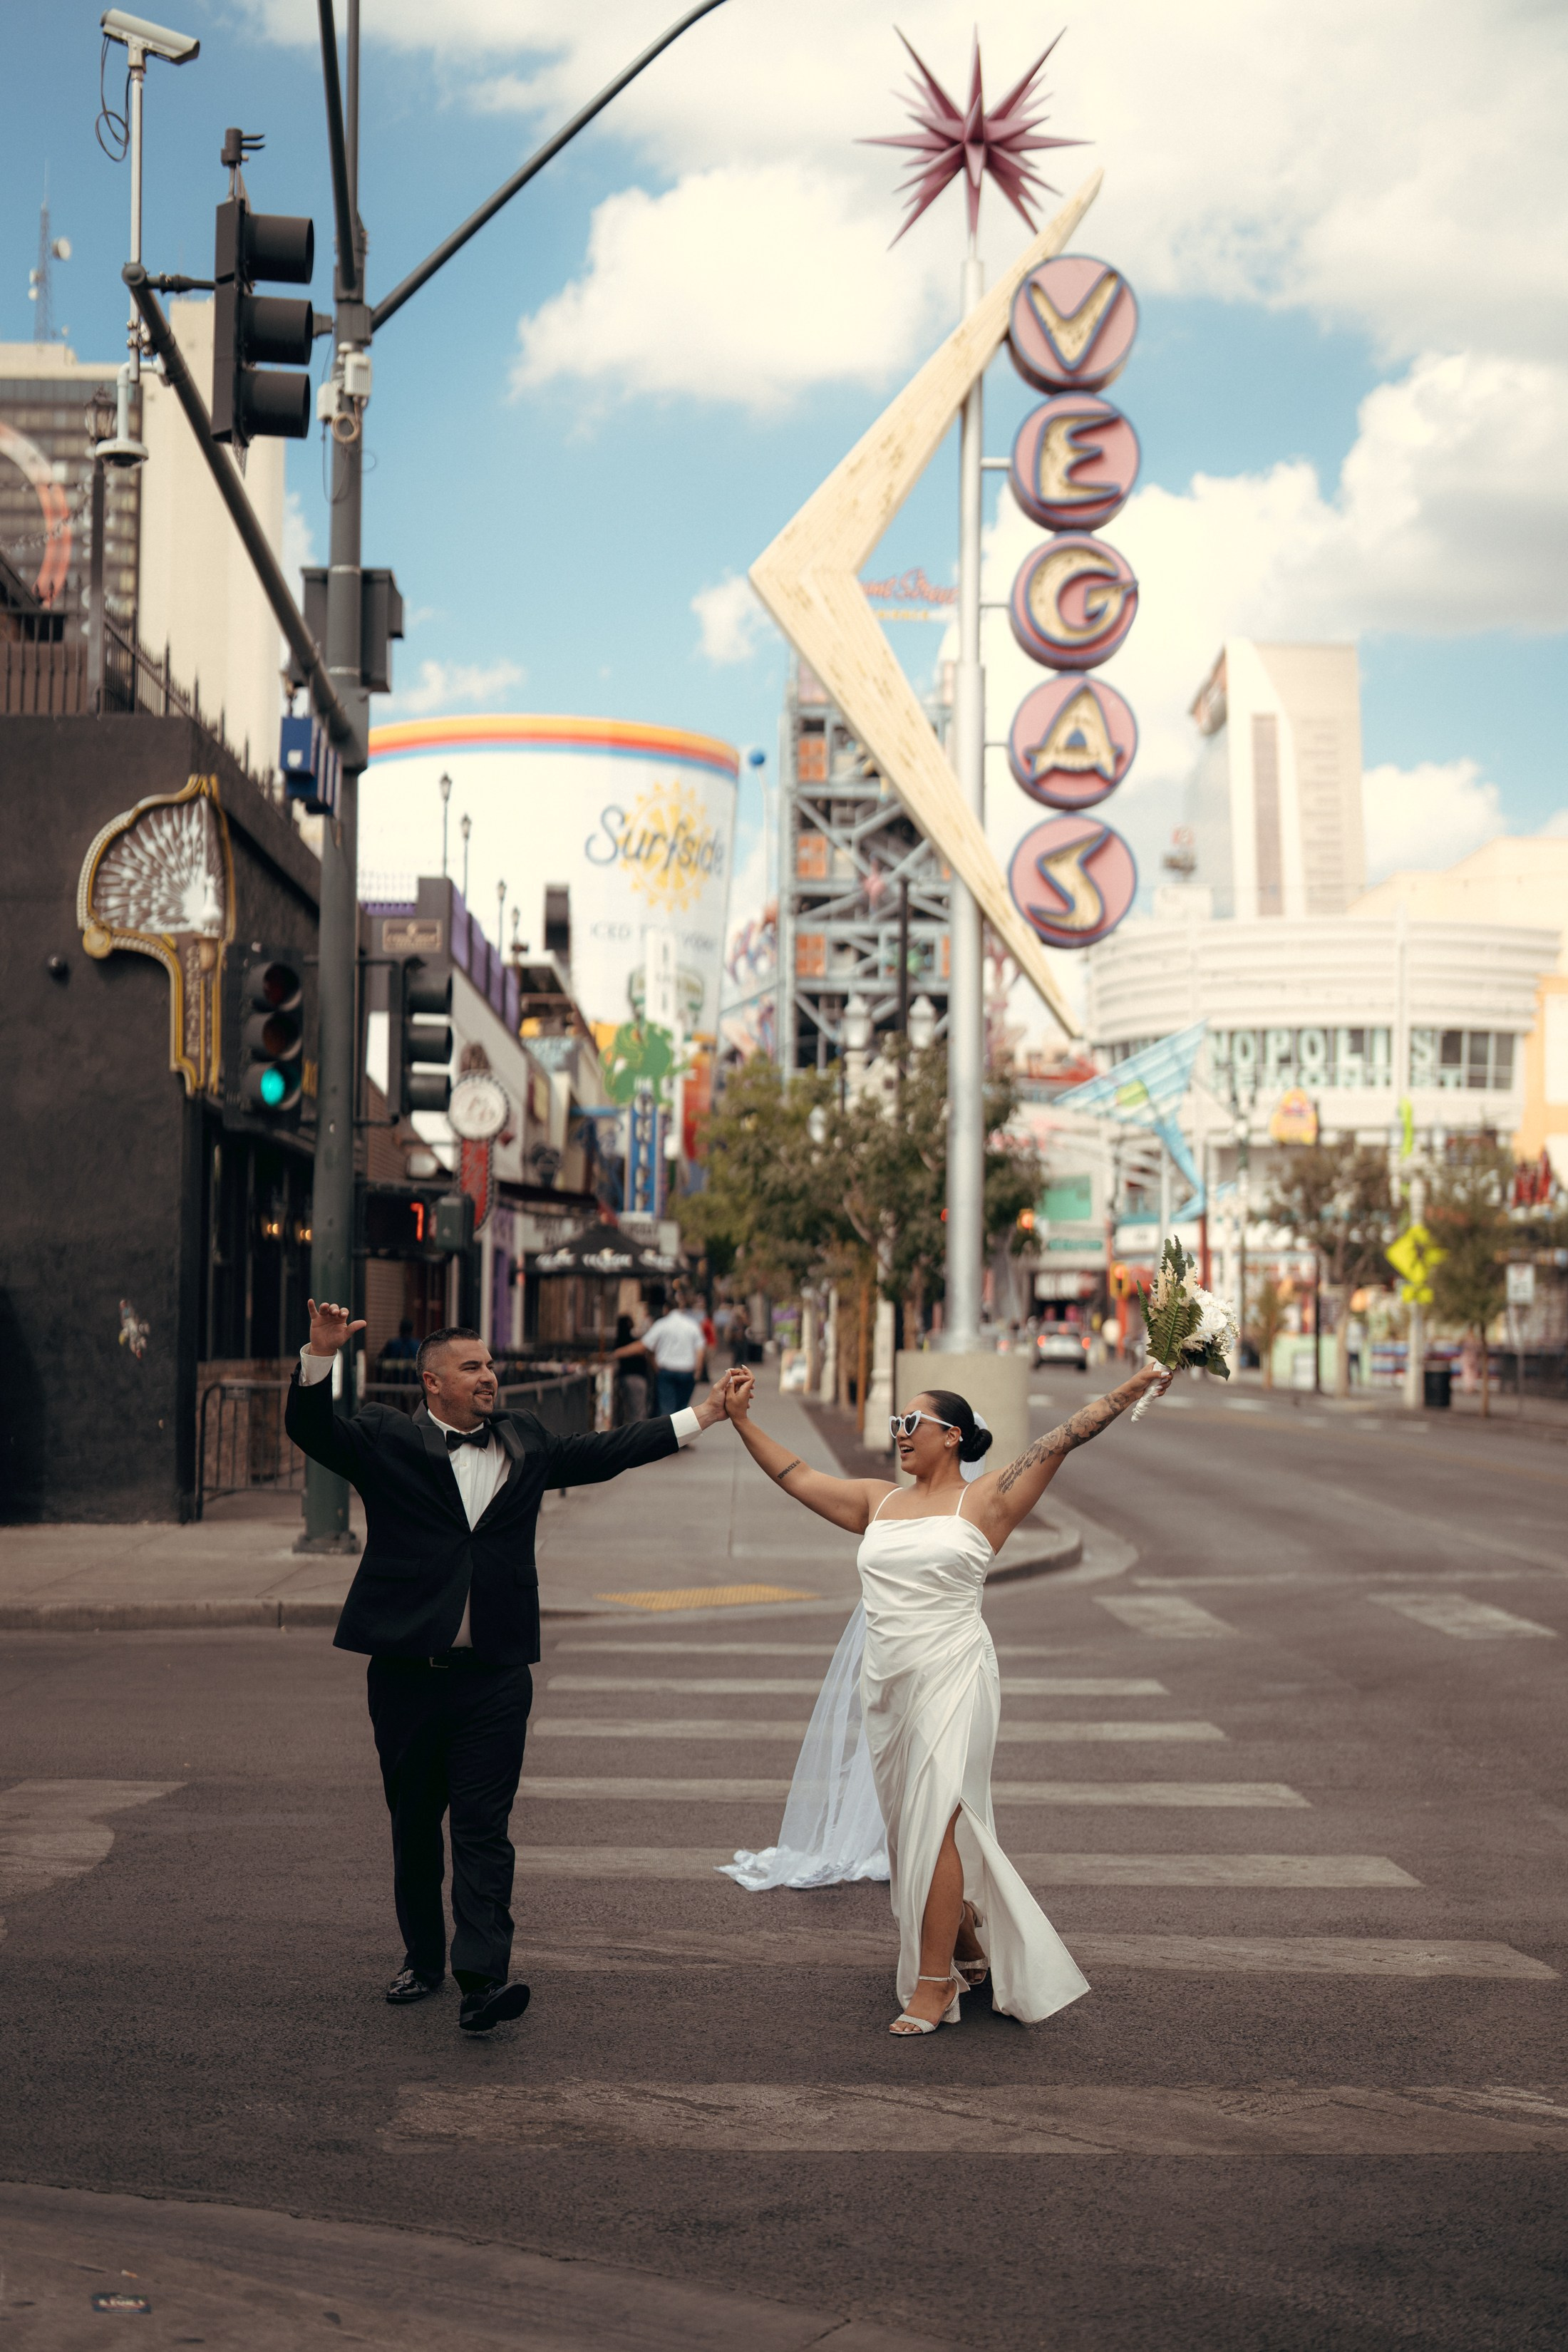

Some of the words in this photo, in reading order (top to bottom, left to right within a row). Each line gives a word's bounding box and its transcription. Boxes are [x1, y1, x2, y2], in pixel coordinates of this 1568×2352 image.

[1022, 267, 1138, 932] VEGAS
[584, 805, 725, 880] Surfside
[1207, 1028, 1435, 1068] NOPOLIS
